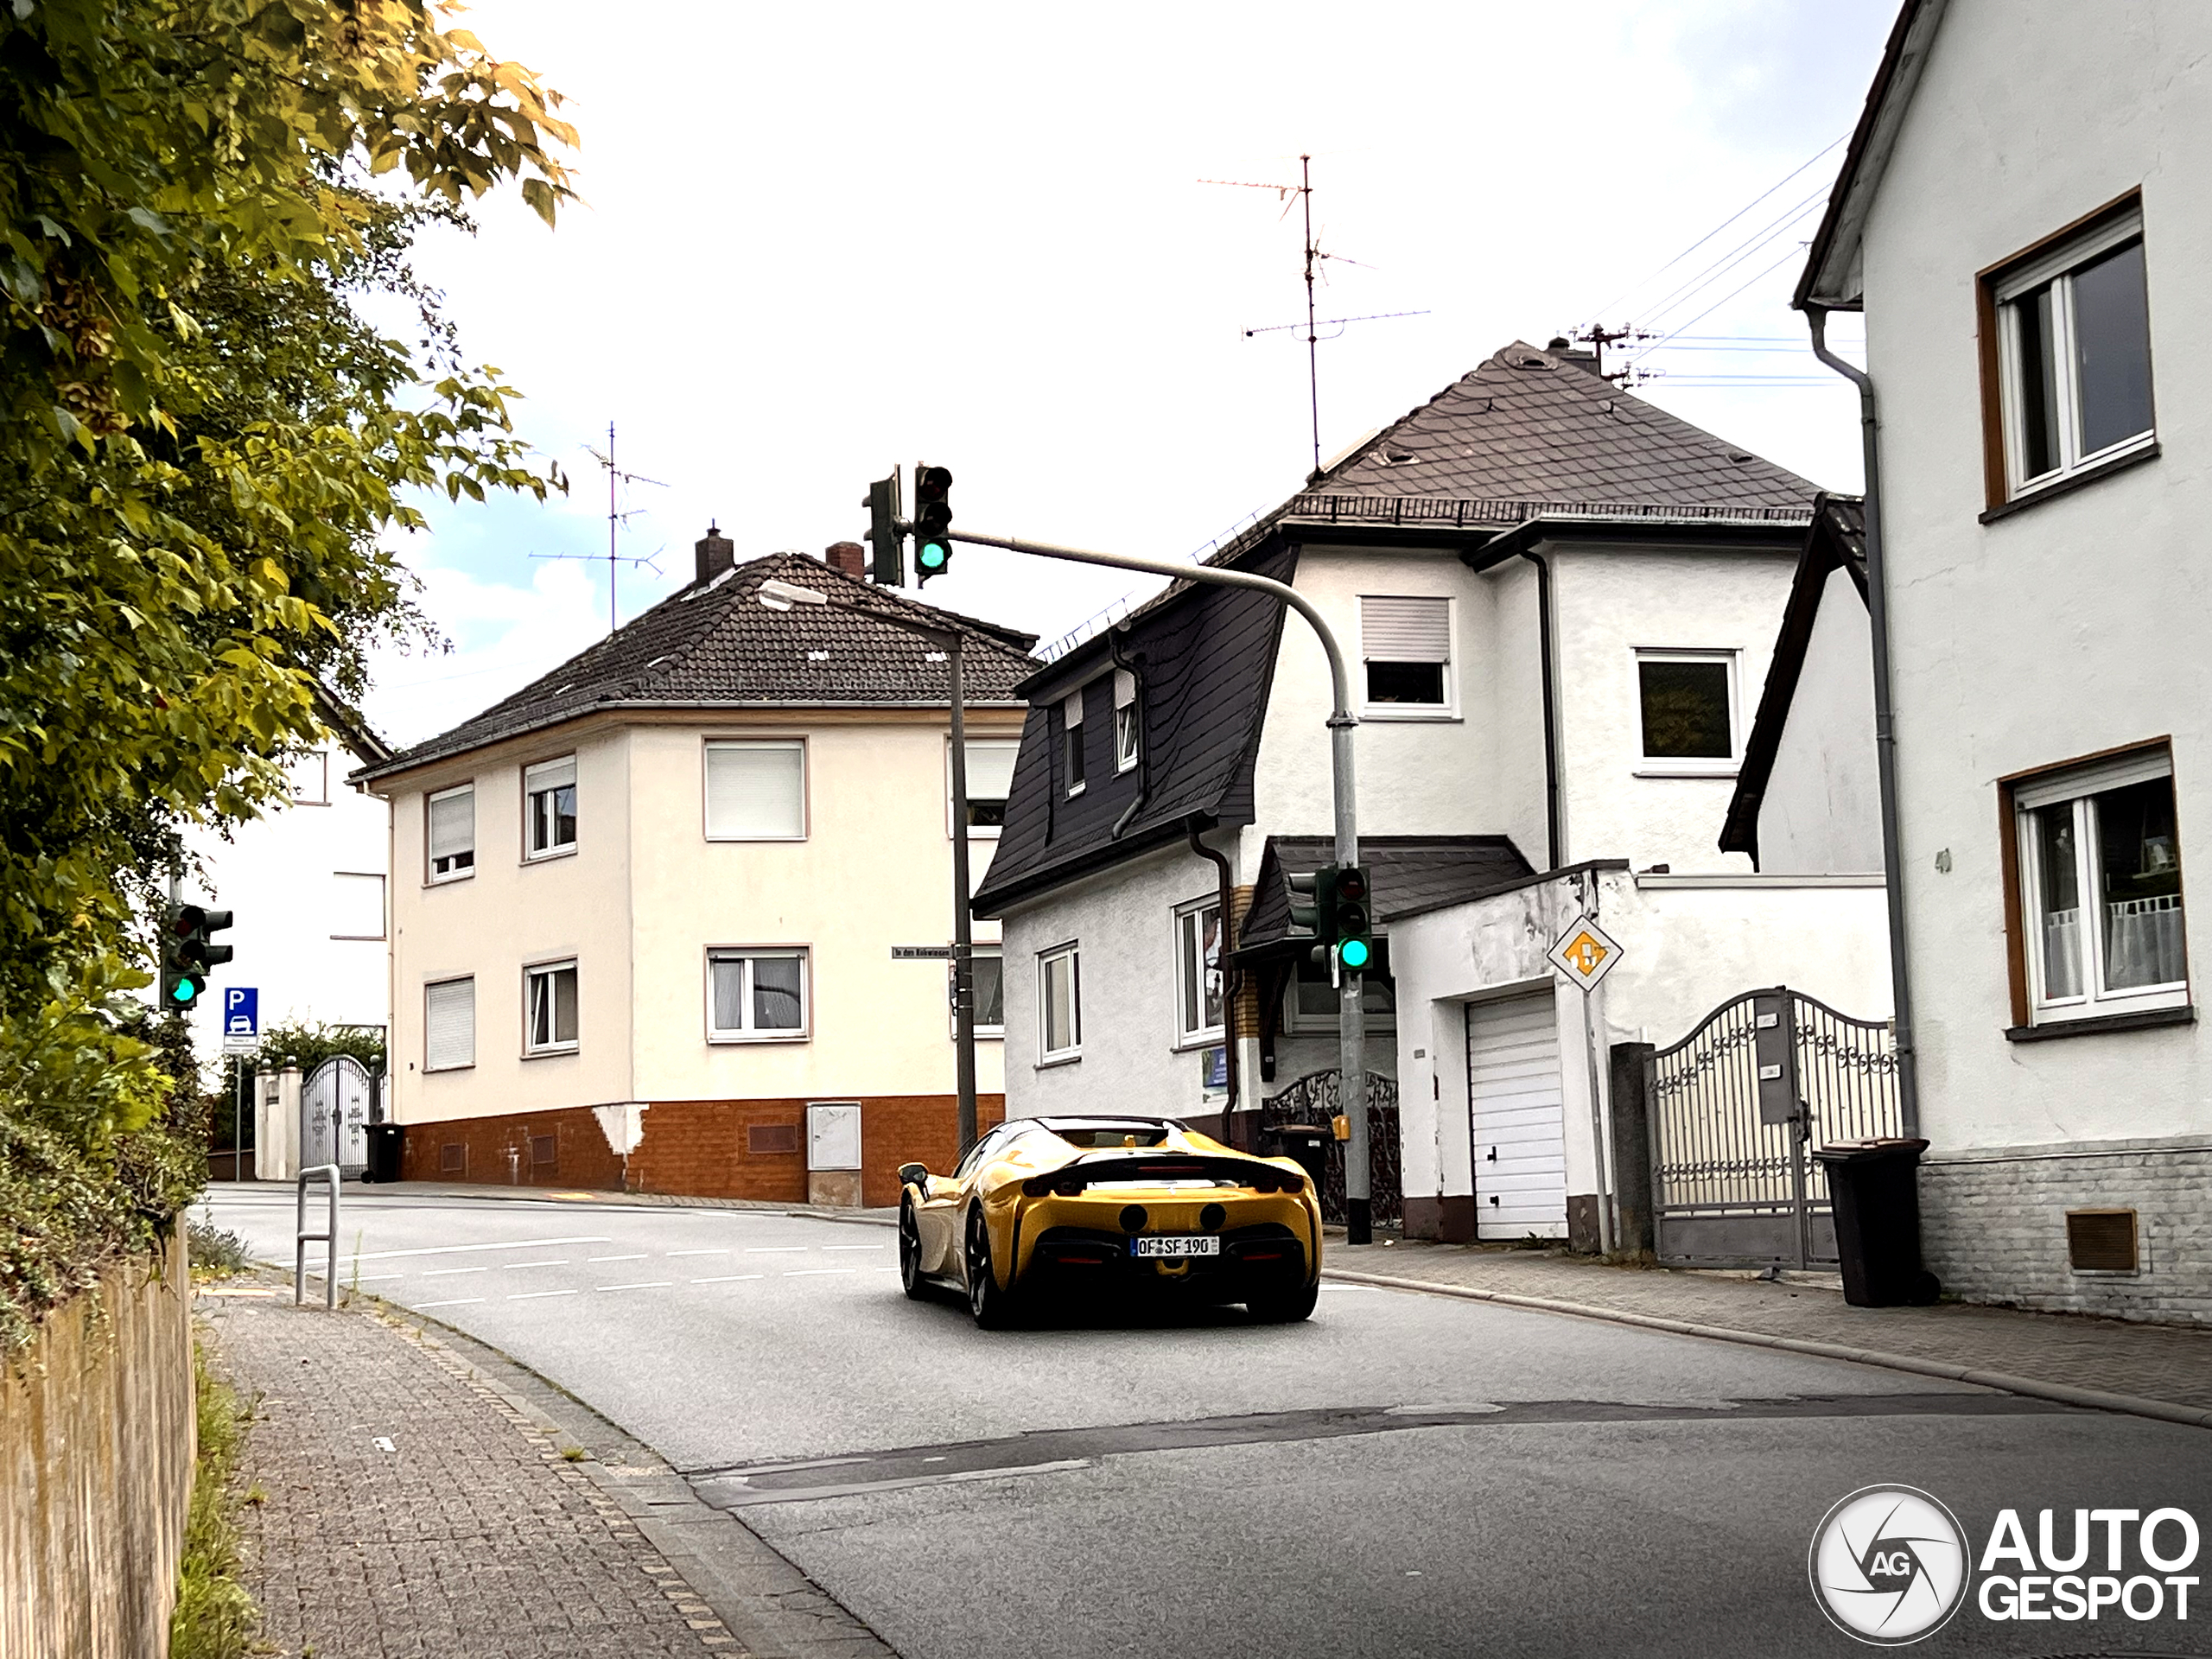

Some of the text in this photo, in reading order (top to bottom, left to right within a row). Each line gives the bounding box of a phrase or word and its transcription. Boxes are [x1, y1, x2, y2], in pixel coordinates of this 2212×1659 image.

[229, 990, 245, 1010] P
[1139, 1240, 1155, 1254] OF
[1165, 1239, 1181, 1254] SF
[1184, 1239, 1209, 1254] 190
